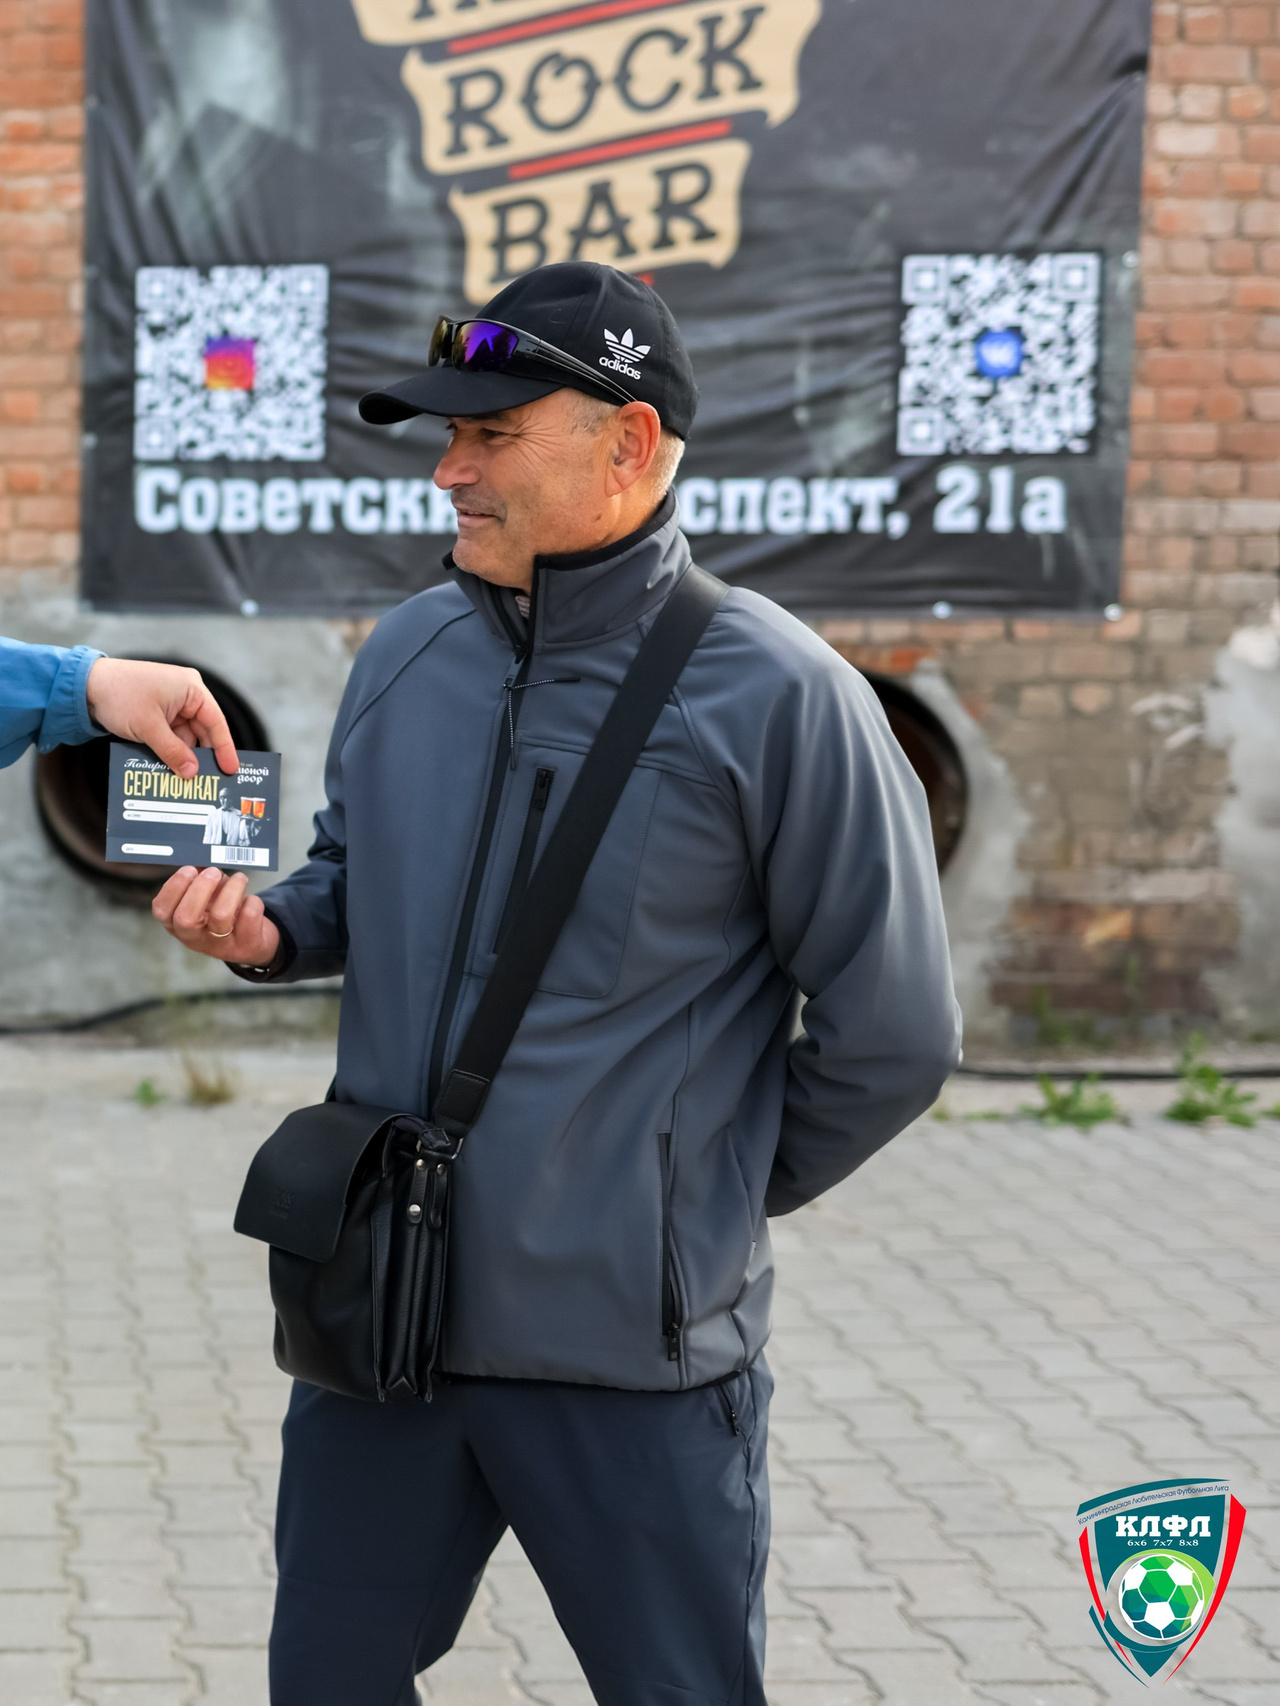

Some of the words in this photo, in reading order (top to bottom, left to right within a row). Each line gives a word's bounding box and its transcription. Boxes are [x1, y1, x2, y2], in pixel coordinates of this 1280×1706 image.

[444, 6, 765, 156] ROCK
[488, 161, 717, 284] BAR
[599, 356, 641, 380] adidas
[134, 467, 461, 535] Советски
[677, 476, 910, 540] спект,
[933, 464, 1068, 534] 21а
[123, 757, 170, 773] Подаро
[236, 766, 269, 777] ивной
[123, 769, 221, 802] СЕРТИФИКАТ
